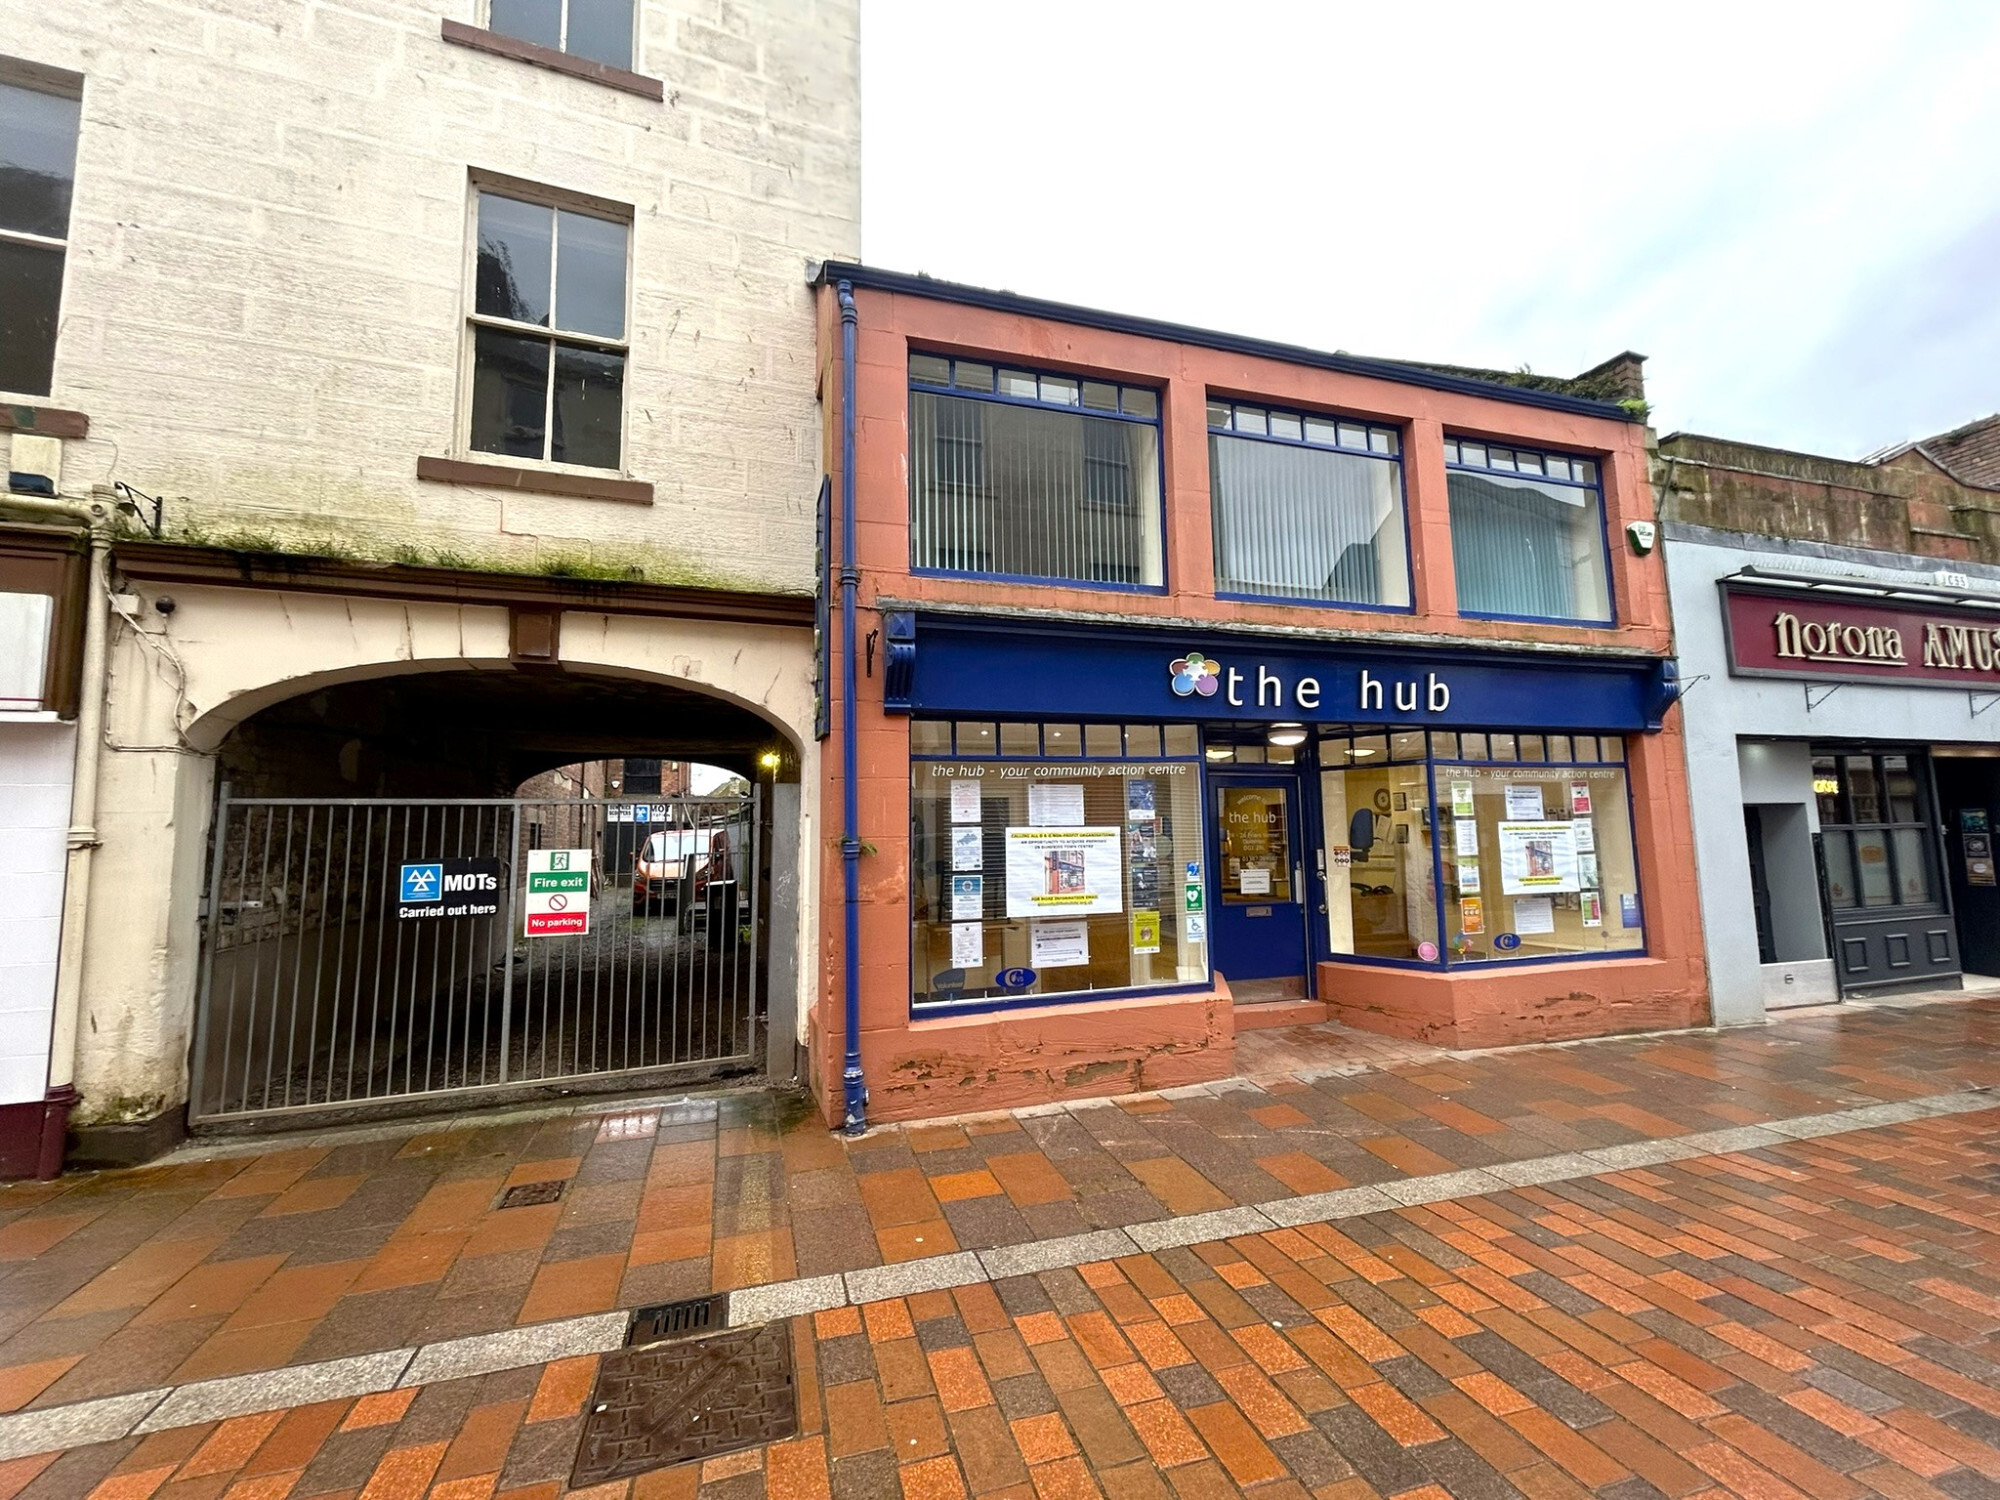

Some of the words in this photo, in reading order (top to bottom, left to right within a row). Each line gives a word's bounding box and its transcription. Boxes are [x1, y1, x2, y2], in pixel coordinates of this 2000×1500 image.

[1227, 665, 1320, 708] the
[1361, 669, 1450, 712] hub
[932, 765, 954, 776] the
[959, 764, 984, 776] hub
[1000, 766, 1030, 779] your
[1034, 765, 1104, 778] community
[1108, 764, 1144, 776] action
[1148, 765, 1186, 774] centre
[1445, 768, 1460, 777] the
[1464, 769, 1480, 778] hub
[1490, 771, 1510, 780] your
[1512, 770, 1560, 779] community
[1562, 770, 1587, 778] action
[1228, 812, 1249, 824] the
[1253, 812, 1276, 824] hub
[444, 873, 497, 892] MOTs
[534, 878, 558, 888] Fire
[561, 876, 583, 887] exit
[400, 906, 444, 918] Carried
[448, 906, 467, 916] out
[470, 904, 496, 914] here
[532, 919, 545, 927] No
[548, 918, 582, 928] parking
